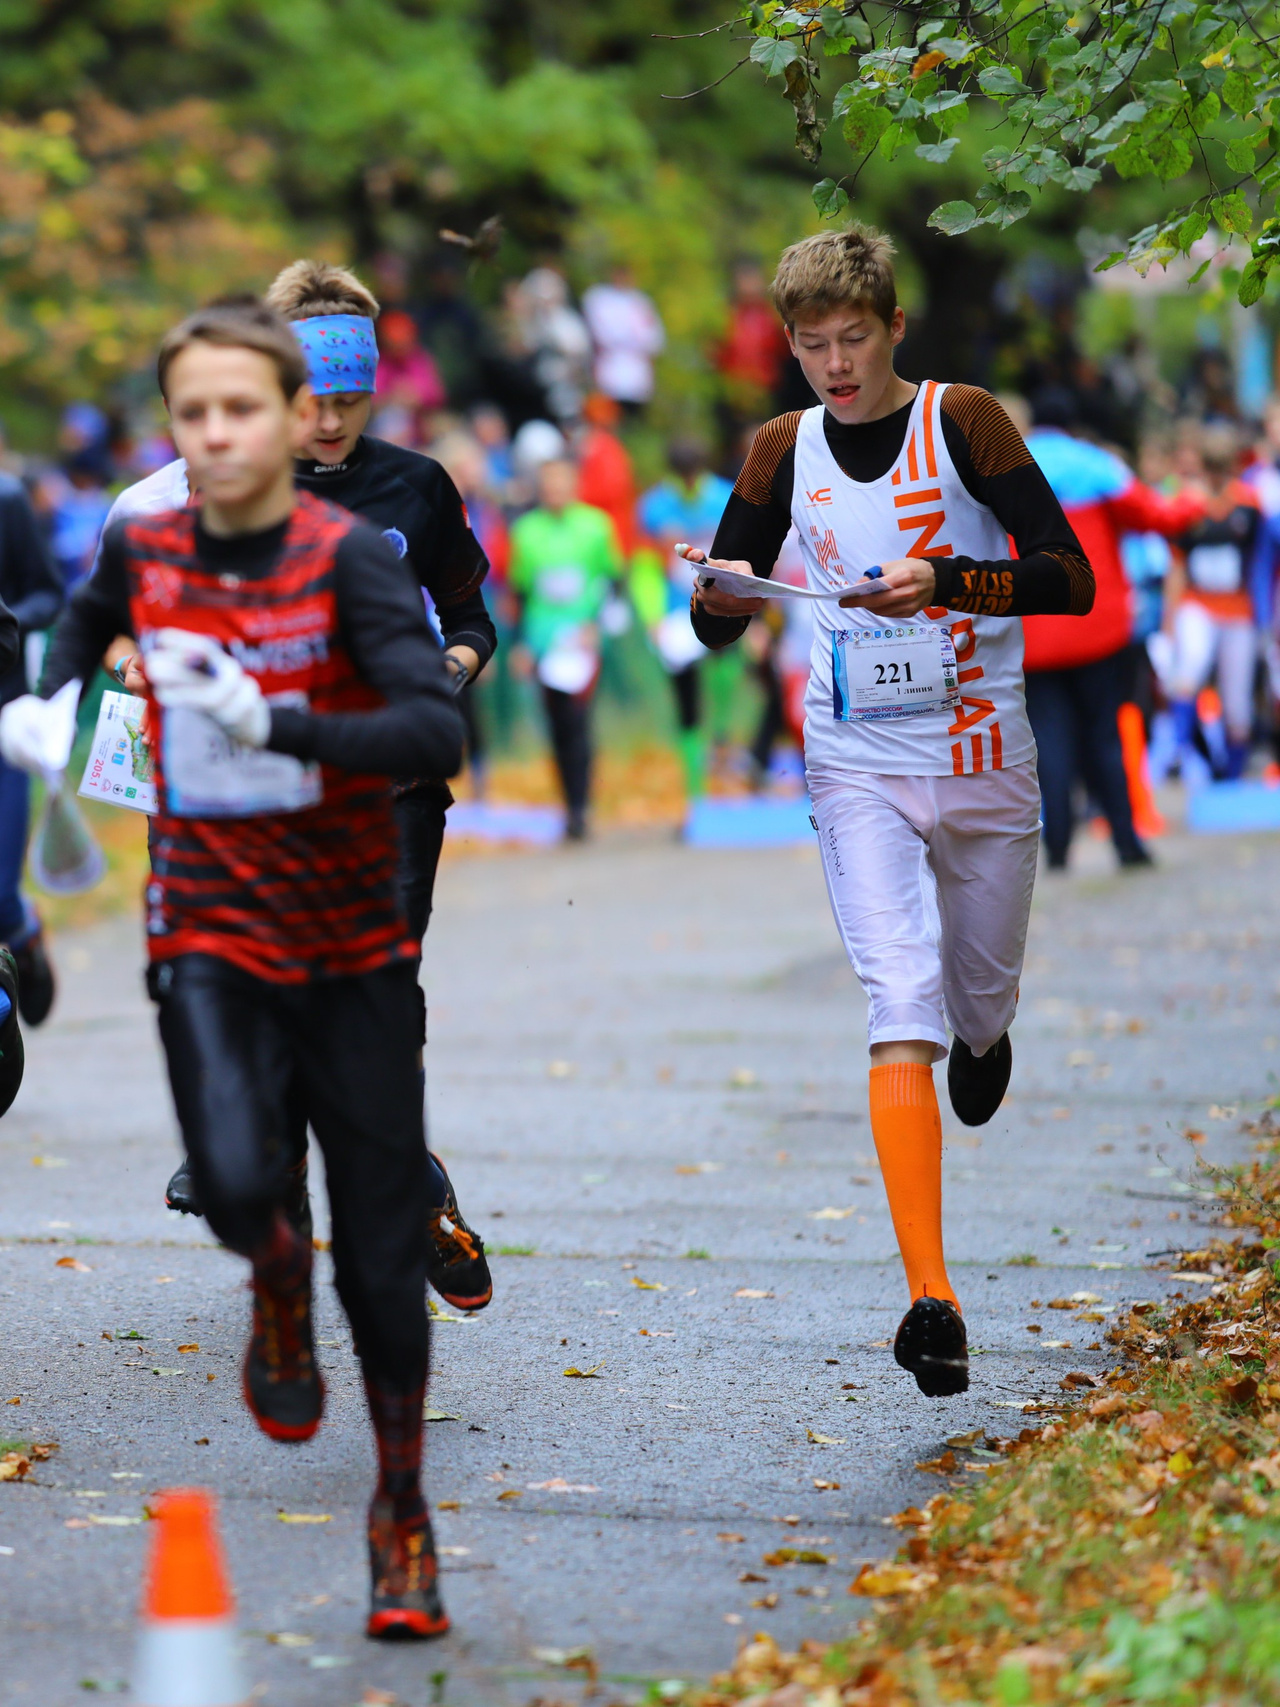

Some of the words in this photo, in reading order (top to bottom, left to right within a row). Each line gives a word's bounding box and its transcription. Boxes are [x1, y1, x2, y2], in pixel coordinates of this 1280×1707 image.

[873, 661, 914, 685] 221
[896, 687, 901, 695] 1
[903, 686, 933, 695] линия
[89, 758, 105, 787] 205.1
